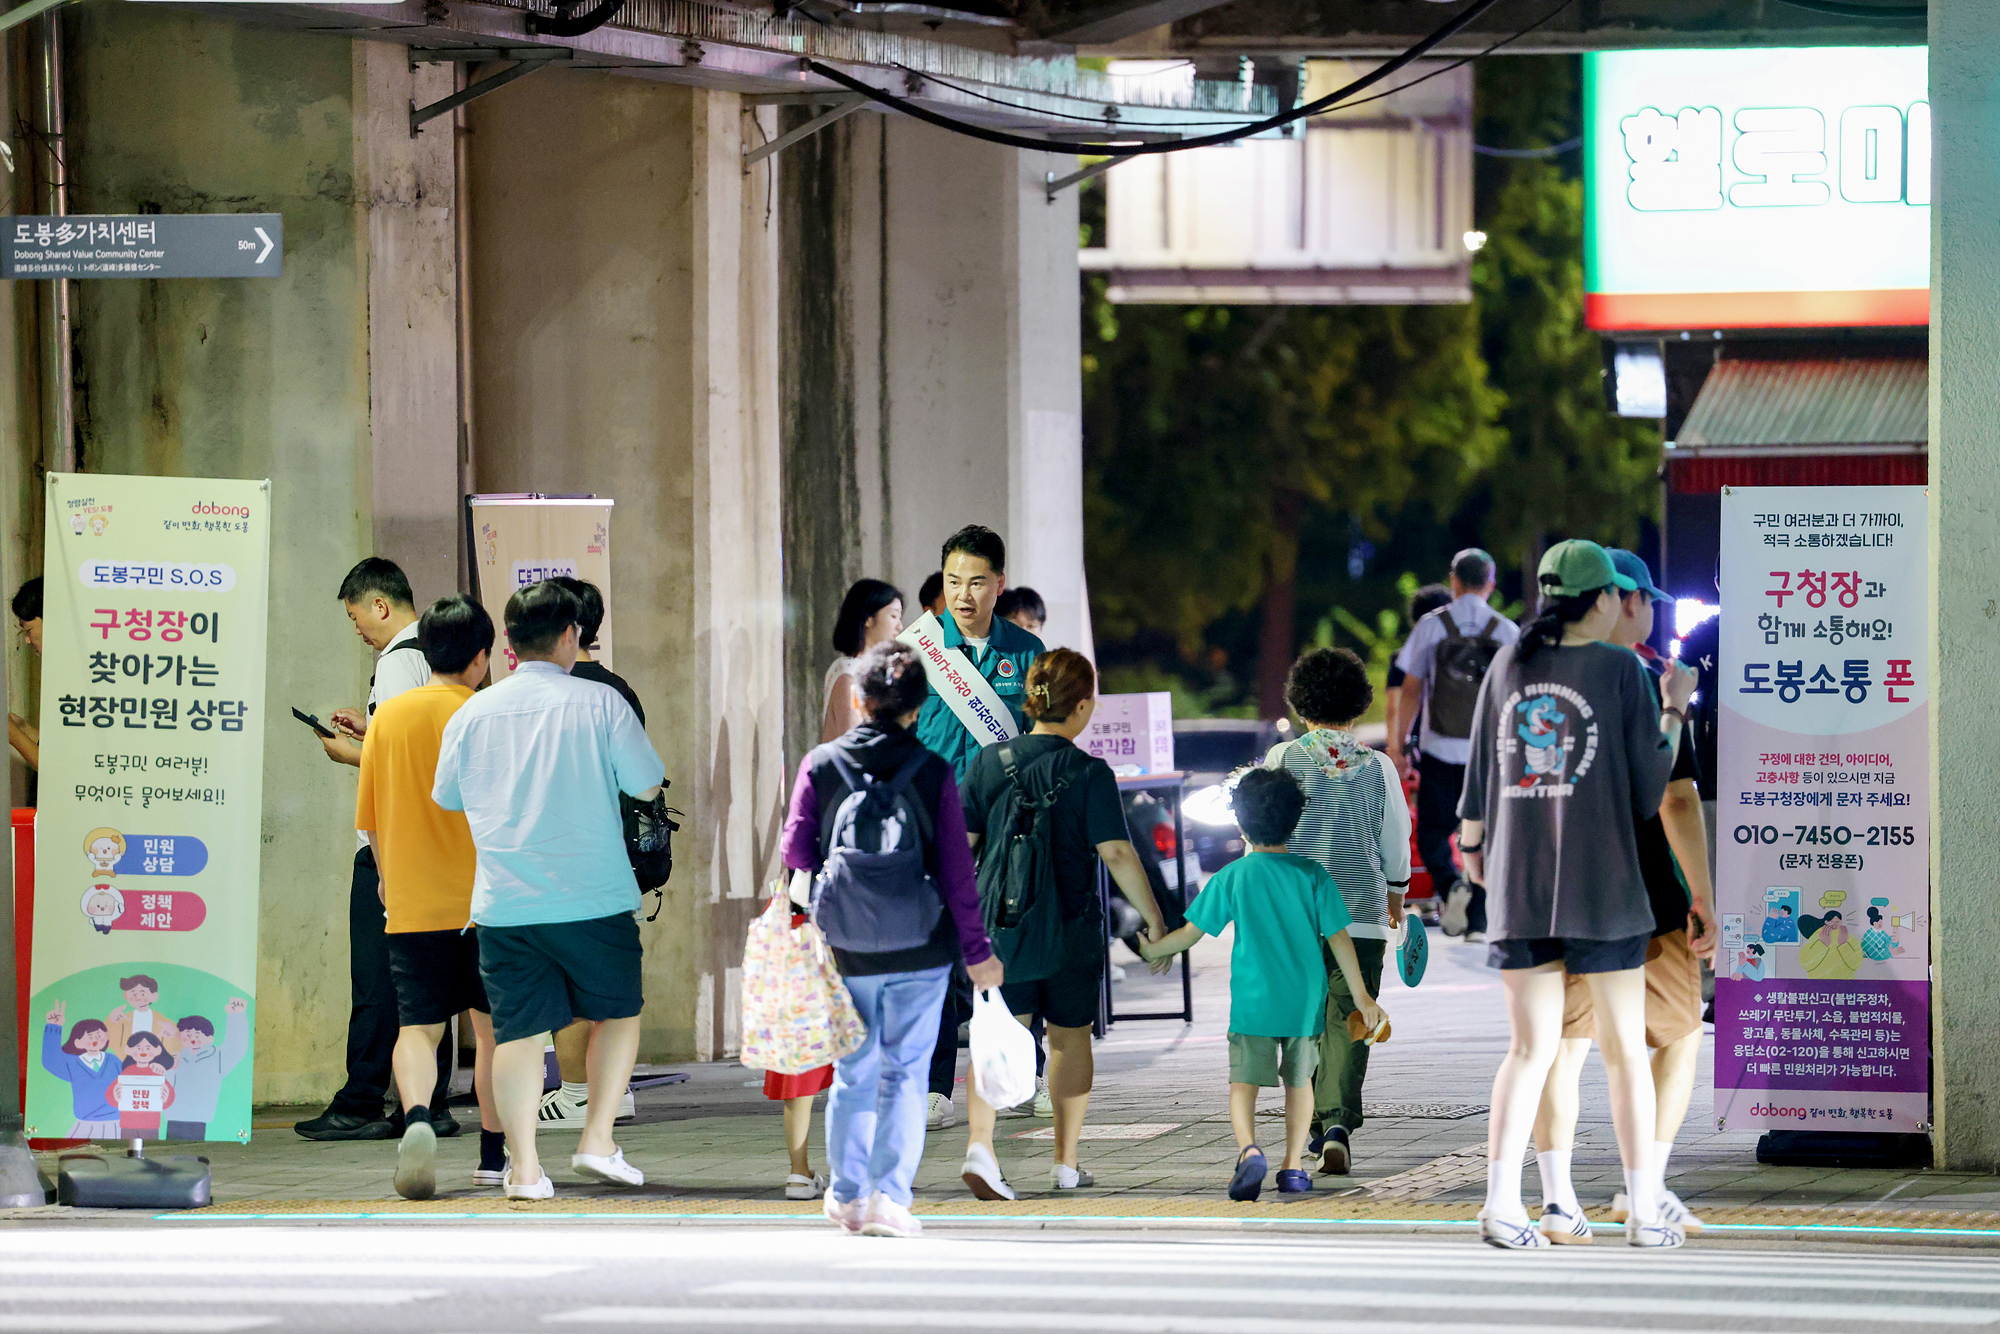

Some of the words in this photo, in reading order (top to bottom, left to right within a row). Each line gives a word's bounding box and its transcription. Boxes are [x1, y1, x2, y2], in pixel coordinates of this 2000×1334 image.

[14, 221, 156, 247] 도봉多가치센터
[238, 240, 256, 250] 50m
[14, 250, 44, 260] Dobong
[45, 250, 71, 259] Shared
[73, 250, 93, 259] Value
[95, 250, 138, 260] Community
[140, 250, 164, 259] Center
[83, 506, 99, 514] YES!
[192, 500, 250, 519] dobong
[163, 520, 179, 530] 같이
[204, 520, 231, 532] 행복한
[234, 521, 249, 533] 도봉
[1753, 513, 1780, 528] 구민
[1784, 513, 1839, 528] 여러분과
[1843, 513, 1856, 527] 더
[1860, 513, 1904, 528] 가까이,
[1763, 533, 1790, 548] 적극
[1794, 533, 1893, 548] 소통하겠습니다!
[93, 565, 164, 585] 도봉구민
[170, 568, 223, 587] S.O.S
[90, 608, 219, 643] 구청장이
[1757, 612, 1806, 645] 함께
[1813, 615, 1893, 646] 소통해요!
[89, 651, 219, 687] 찾아가는
[918, 635, 972, 697] 도봉구청장
[1739, 659, 1872, 704] 도봉소통
[1883, 659, 1915, 703] 폰
[58, 694, 178, 730] 현장민원
[186, 699, 248, 731] 상담
[1092, 722, 1131, 735] 도봉구민
[1089, 738, 1136, 756] 생각함
[94, 754, 147, 774] 도봉구민
[155, 757, 208, 776] 여러분!
[1758, 753, 1792, 766] 구정에
[1794, 753, 1816, 766] 대한
[1818, 753, 1844, 767] 건의,
[1846, 753, 1893, 767] 아이디어,
[1756, 772, 1800, 784] 고충사항
[1802, 772, 1824, 784] 등이
[1827, 772, 1870, 785] 있으시면
[1873, 772, 1895, 785] 지금
[75, 785, 133, 806] 무엇이든
[142, 786, 225, 808] 물어보세요!!
[1739, 791, 1833, 807] 도봉구청장에게
[1836, 792, 1863, 807] 문자
[1866, 792, 1910, 807] 주세요!
[1733, 825, 1915, 846] 010-7450-2155
[144, 839, 175, 855] 민원
[143, 857, 175, 873] 상담
[1779, 853, 1813, 870] (문자
[1816, 854, 1864, 871] 전용폰)
[141, 895, 173, 911] 정책
[140, 913, 172, 929] 제안
[1738, 1009, 1770, 1022] 쓰레기
[1773, 1009, 1819, 1024] 무단투기,
[1821, 1010, 1846, 1024] 소음,
[1849, 1010, 1906, 1026] 불법적치물,
[1743, 1027, 1778, 1041] 광고물,
[1780, 1028, 1826, 1042] 동물사체,
[1829, 1028, 1872, 1042] 수목관리
[1874, 1029, 1901, 1043] 등)는
[1733, 1044, 1830, 1060] 응답소(02-120)을
[1832, 1046, 1854, 1059] 통해
[1856, 1046, 1910, 1060] 신고하시면
[1746, 1062, 1757, 1075] 더
[1760, 1062, 1781, 1075] 빠른
[1784, 1063, 1837, 1076] 민원처리가
[1840, 1064, 1897, 1078] 가능합니다.
[132, 1089, 150, 1099] 민원
[131, 1100, 150, 1110] 정책
[1750, 1102, 1807, 1120] dobong
[1809, 1107, 1826, 1118] 같이
[1849, 1107, 1876, 1119] 행복한
[1879, 1108, 1893, 1120] 도봉
